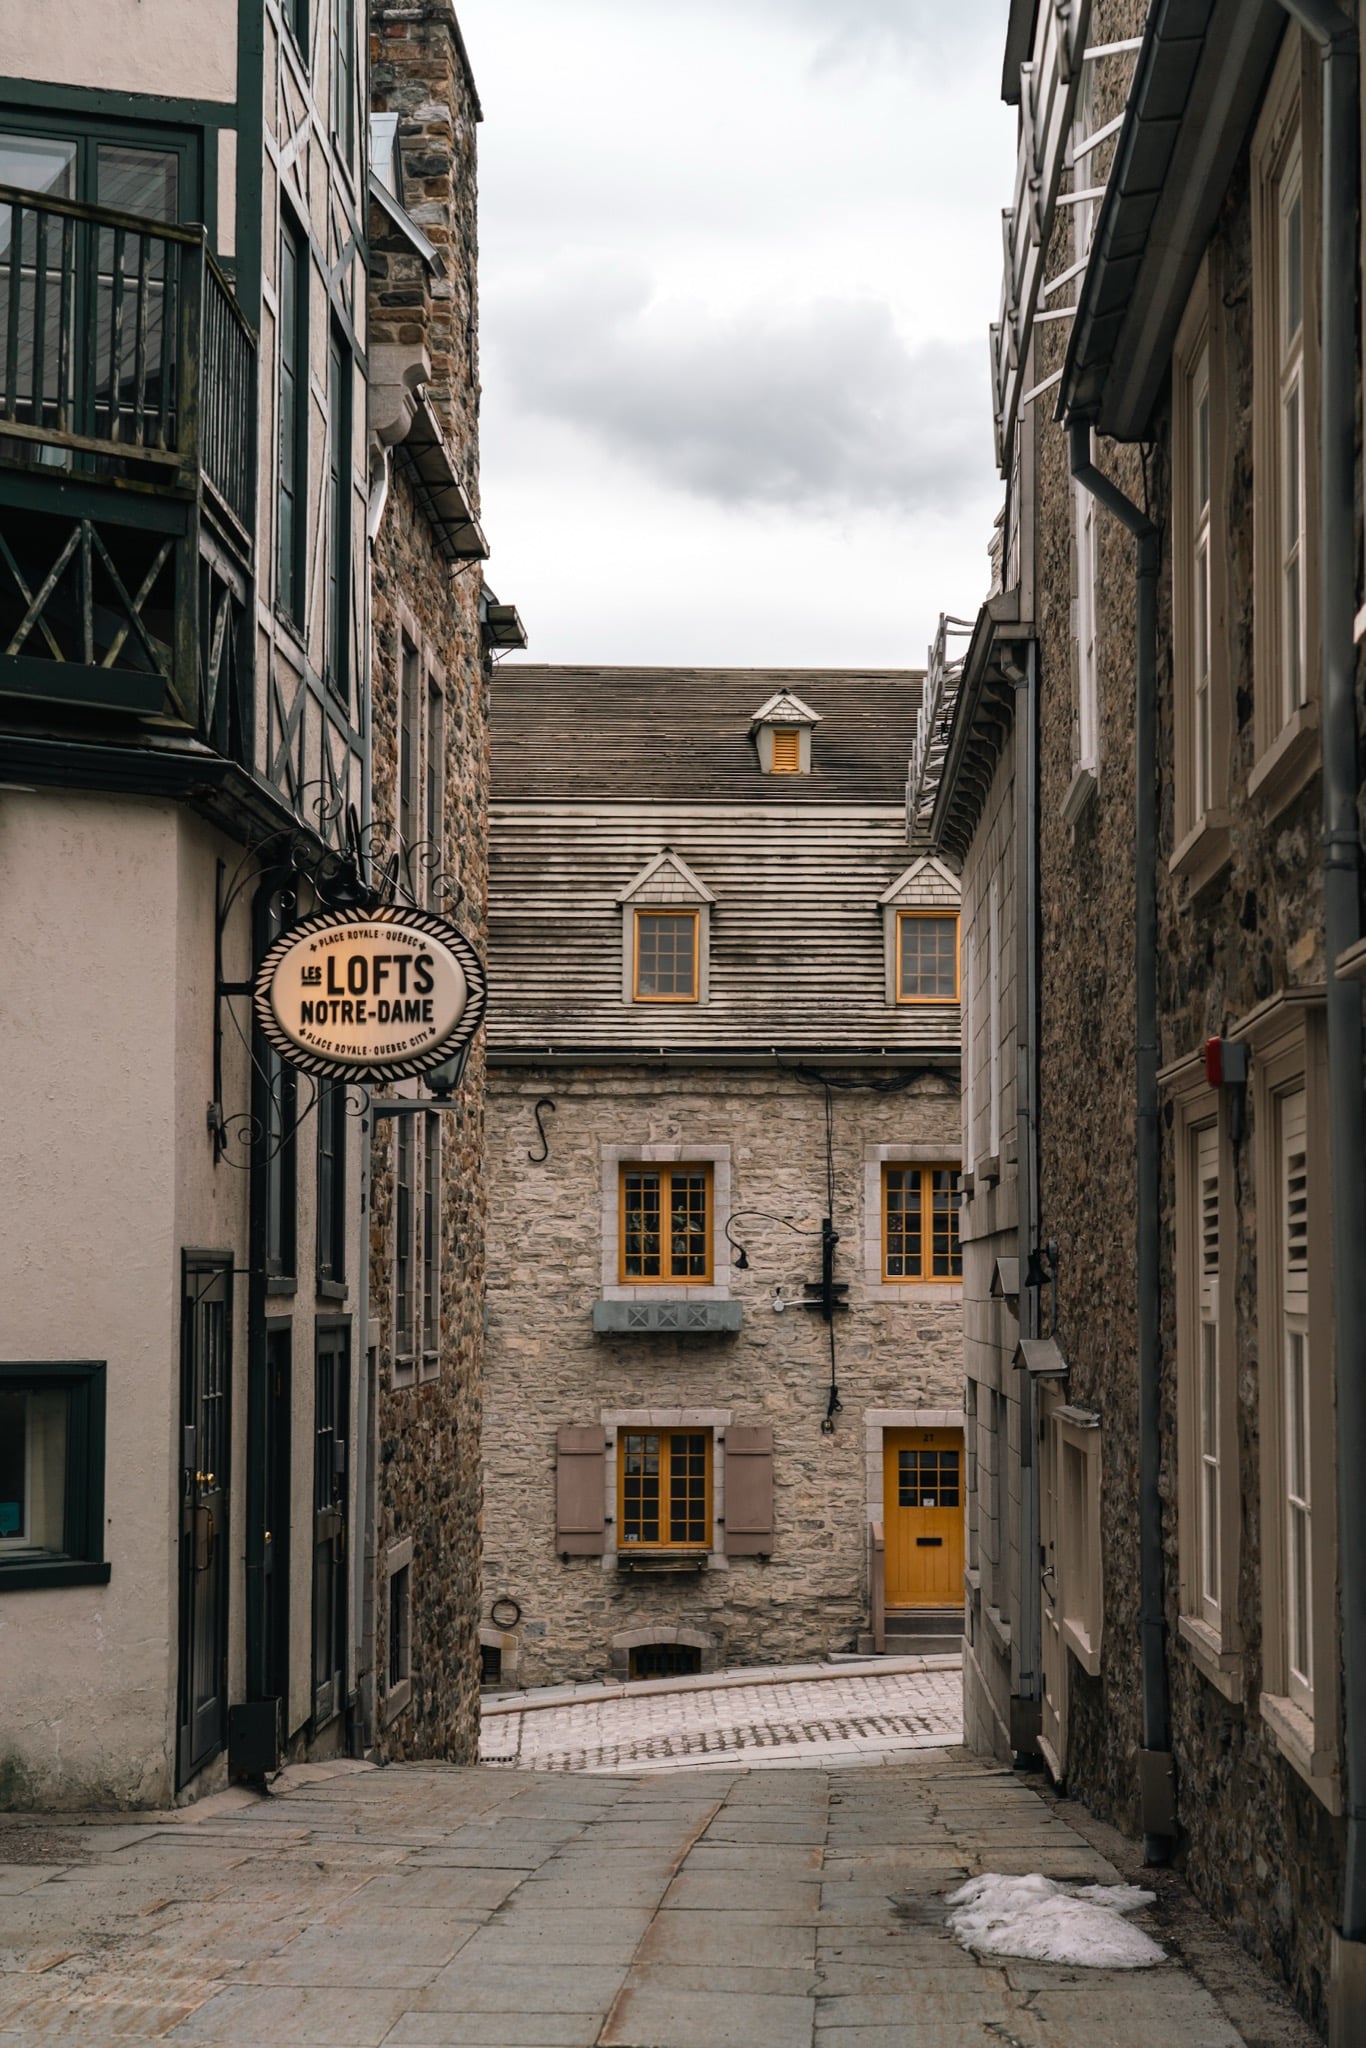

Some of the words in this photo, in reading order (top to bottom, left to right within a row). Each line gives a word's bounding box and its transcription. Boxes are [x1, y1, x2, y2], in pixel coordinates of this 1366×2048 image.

[318, 932, 345, 948] PLACE
[347, 929, 379, 940] ROYALE
[386, 930, 419, 947] QUÉBEC
[301, 966, 322, 980] LES
[327, 954, 434, 996] LOFTS
[301, 999, 434, 1025] NOTRE-DAME
[306, 1032, 332, 1051] PLACE
[334, 1043, 367, 1056] ROYALE
[374, 1041, 408, 1056] QUEBEC
[410, 1033, 429, 1047] CITY
